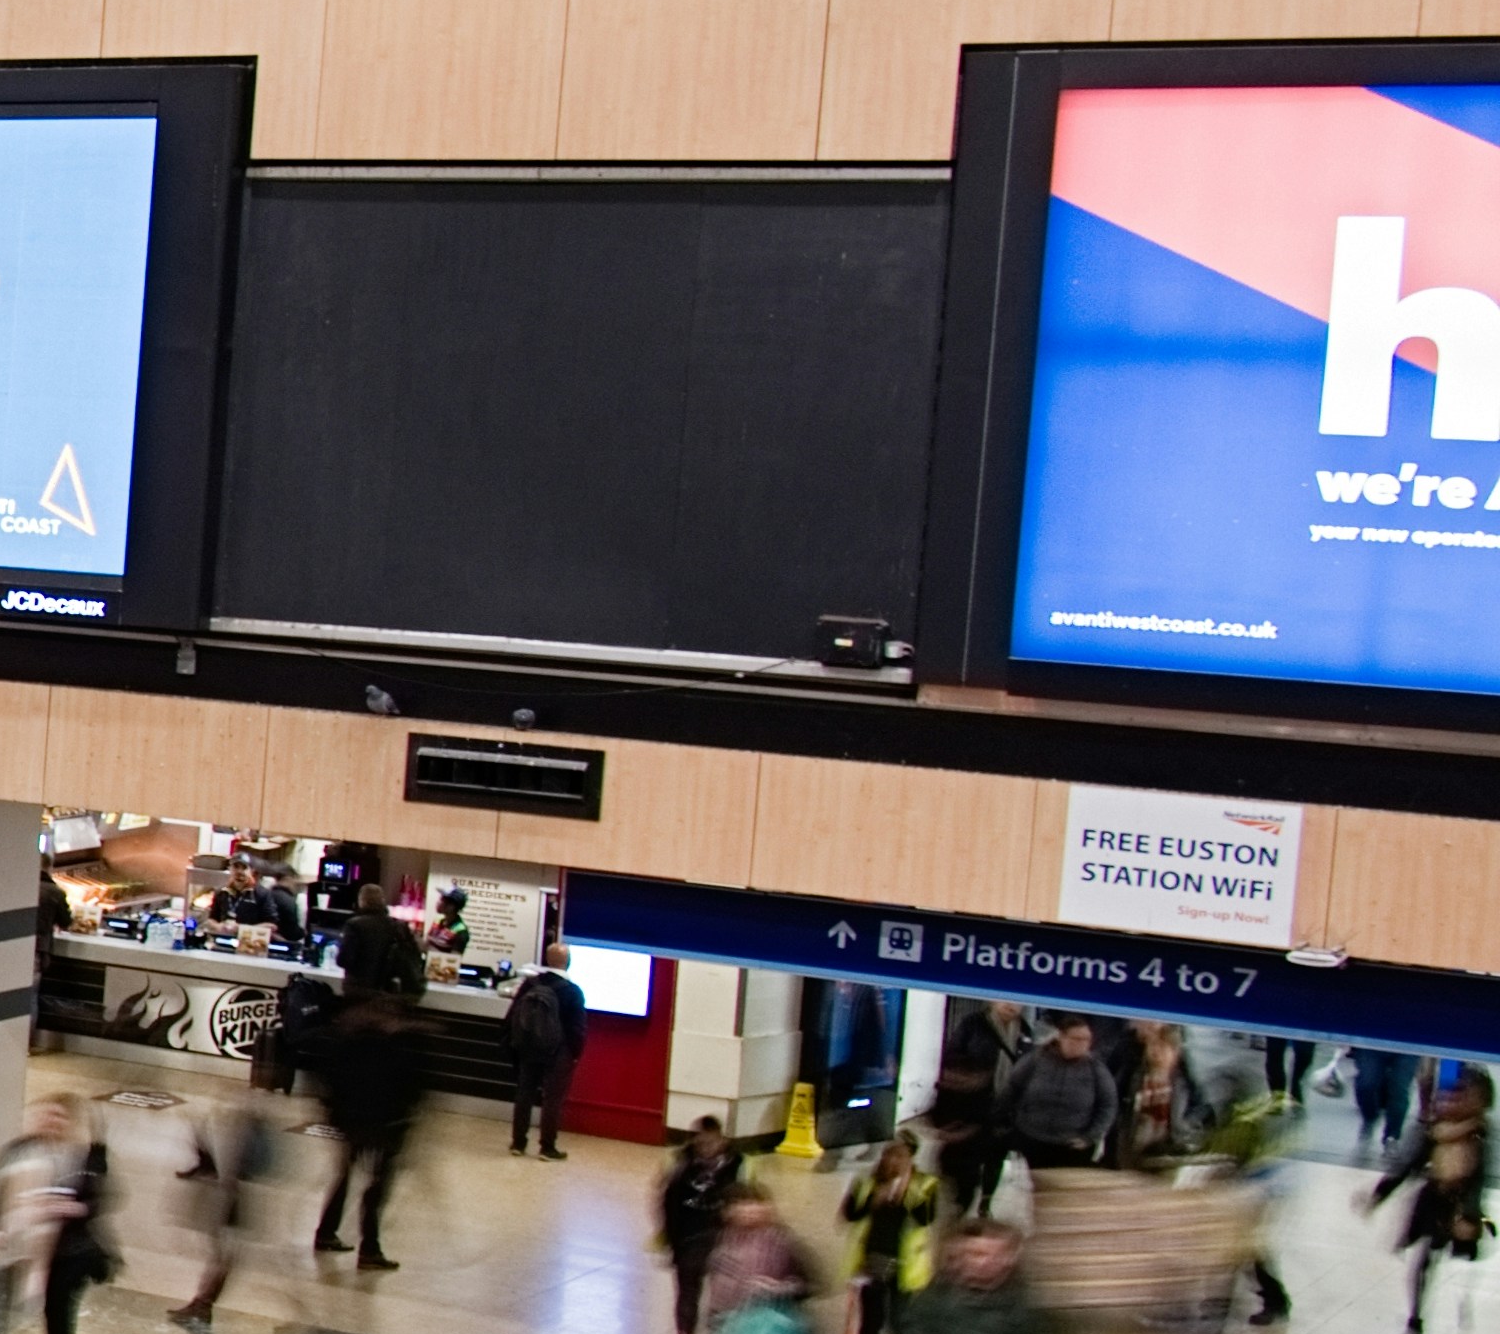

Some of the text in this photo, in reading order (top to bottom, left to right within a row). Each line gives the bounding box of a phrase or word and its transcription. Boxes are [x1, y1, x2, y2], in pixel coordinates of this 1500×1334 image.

[1316, 463, 1477, 509] we're
[1, 517, 61, 535] COAST
[1309, 524, 1360, 542] your
[1362, 527, 1409, 543] new
[1, 590, 105, 617] JCDecaux
[1049, 607, 1277, 639] avantiwestcoast.co.uk
[1081, 828, 1279, 868] FREE EUSTON
[1081, 862, 1274, 901] STATION WiFi
[1177, 905, 1270, 925] Sign-up Now!
[941, 931, 1258, 999] Platforms 4 to 7
